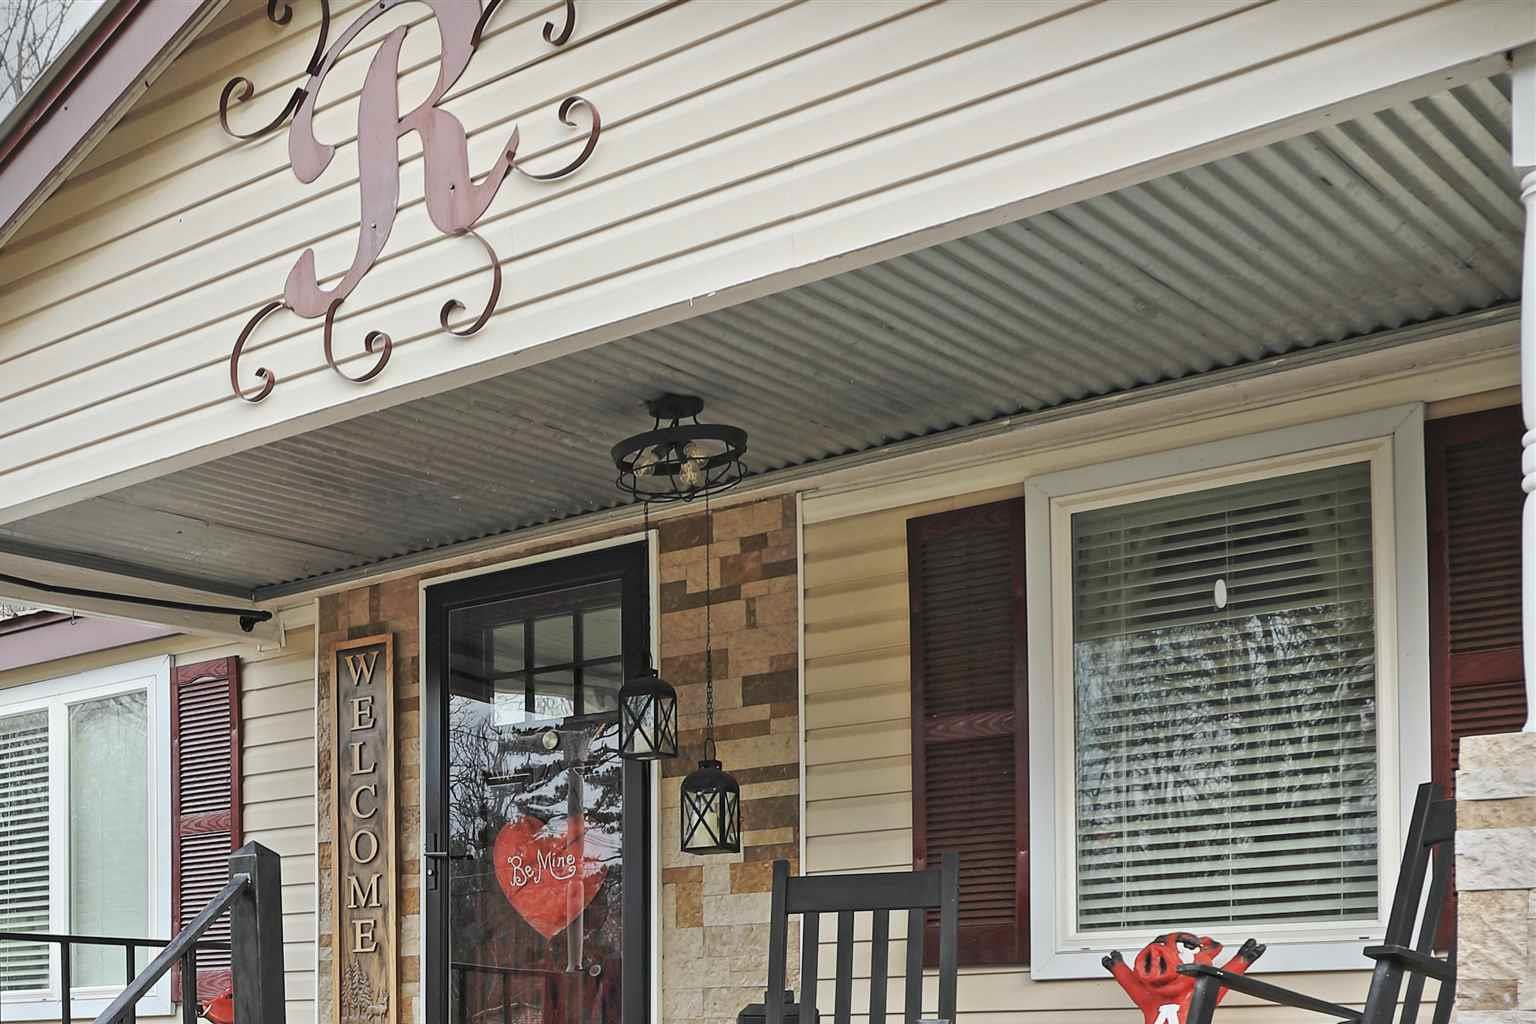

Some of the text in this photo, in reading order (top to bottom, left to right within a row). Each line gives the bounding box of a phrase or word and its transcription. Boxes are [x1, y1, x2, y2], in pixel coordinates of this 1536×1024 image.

[284, 0, 520, 319] R
[345, 650, 381, 953] WELCOME
[508, 848, 576, 886] Be Mine
